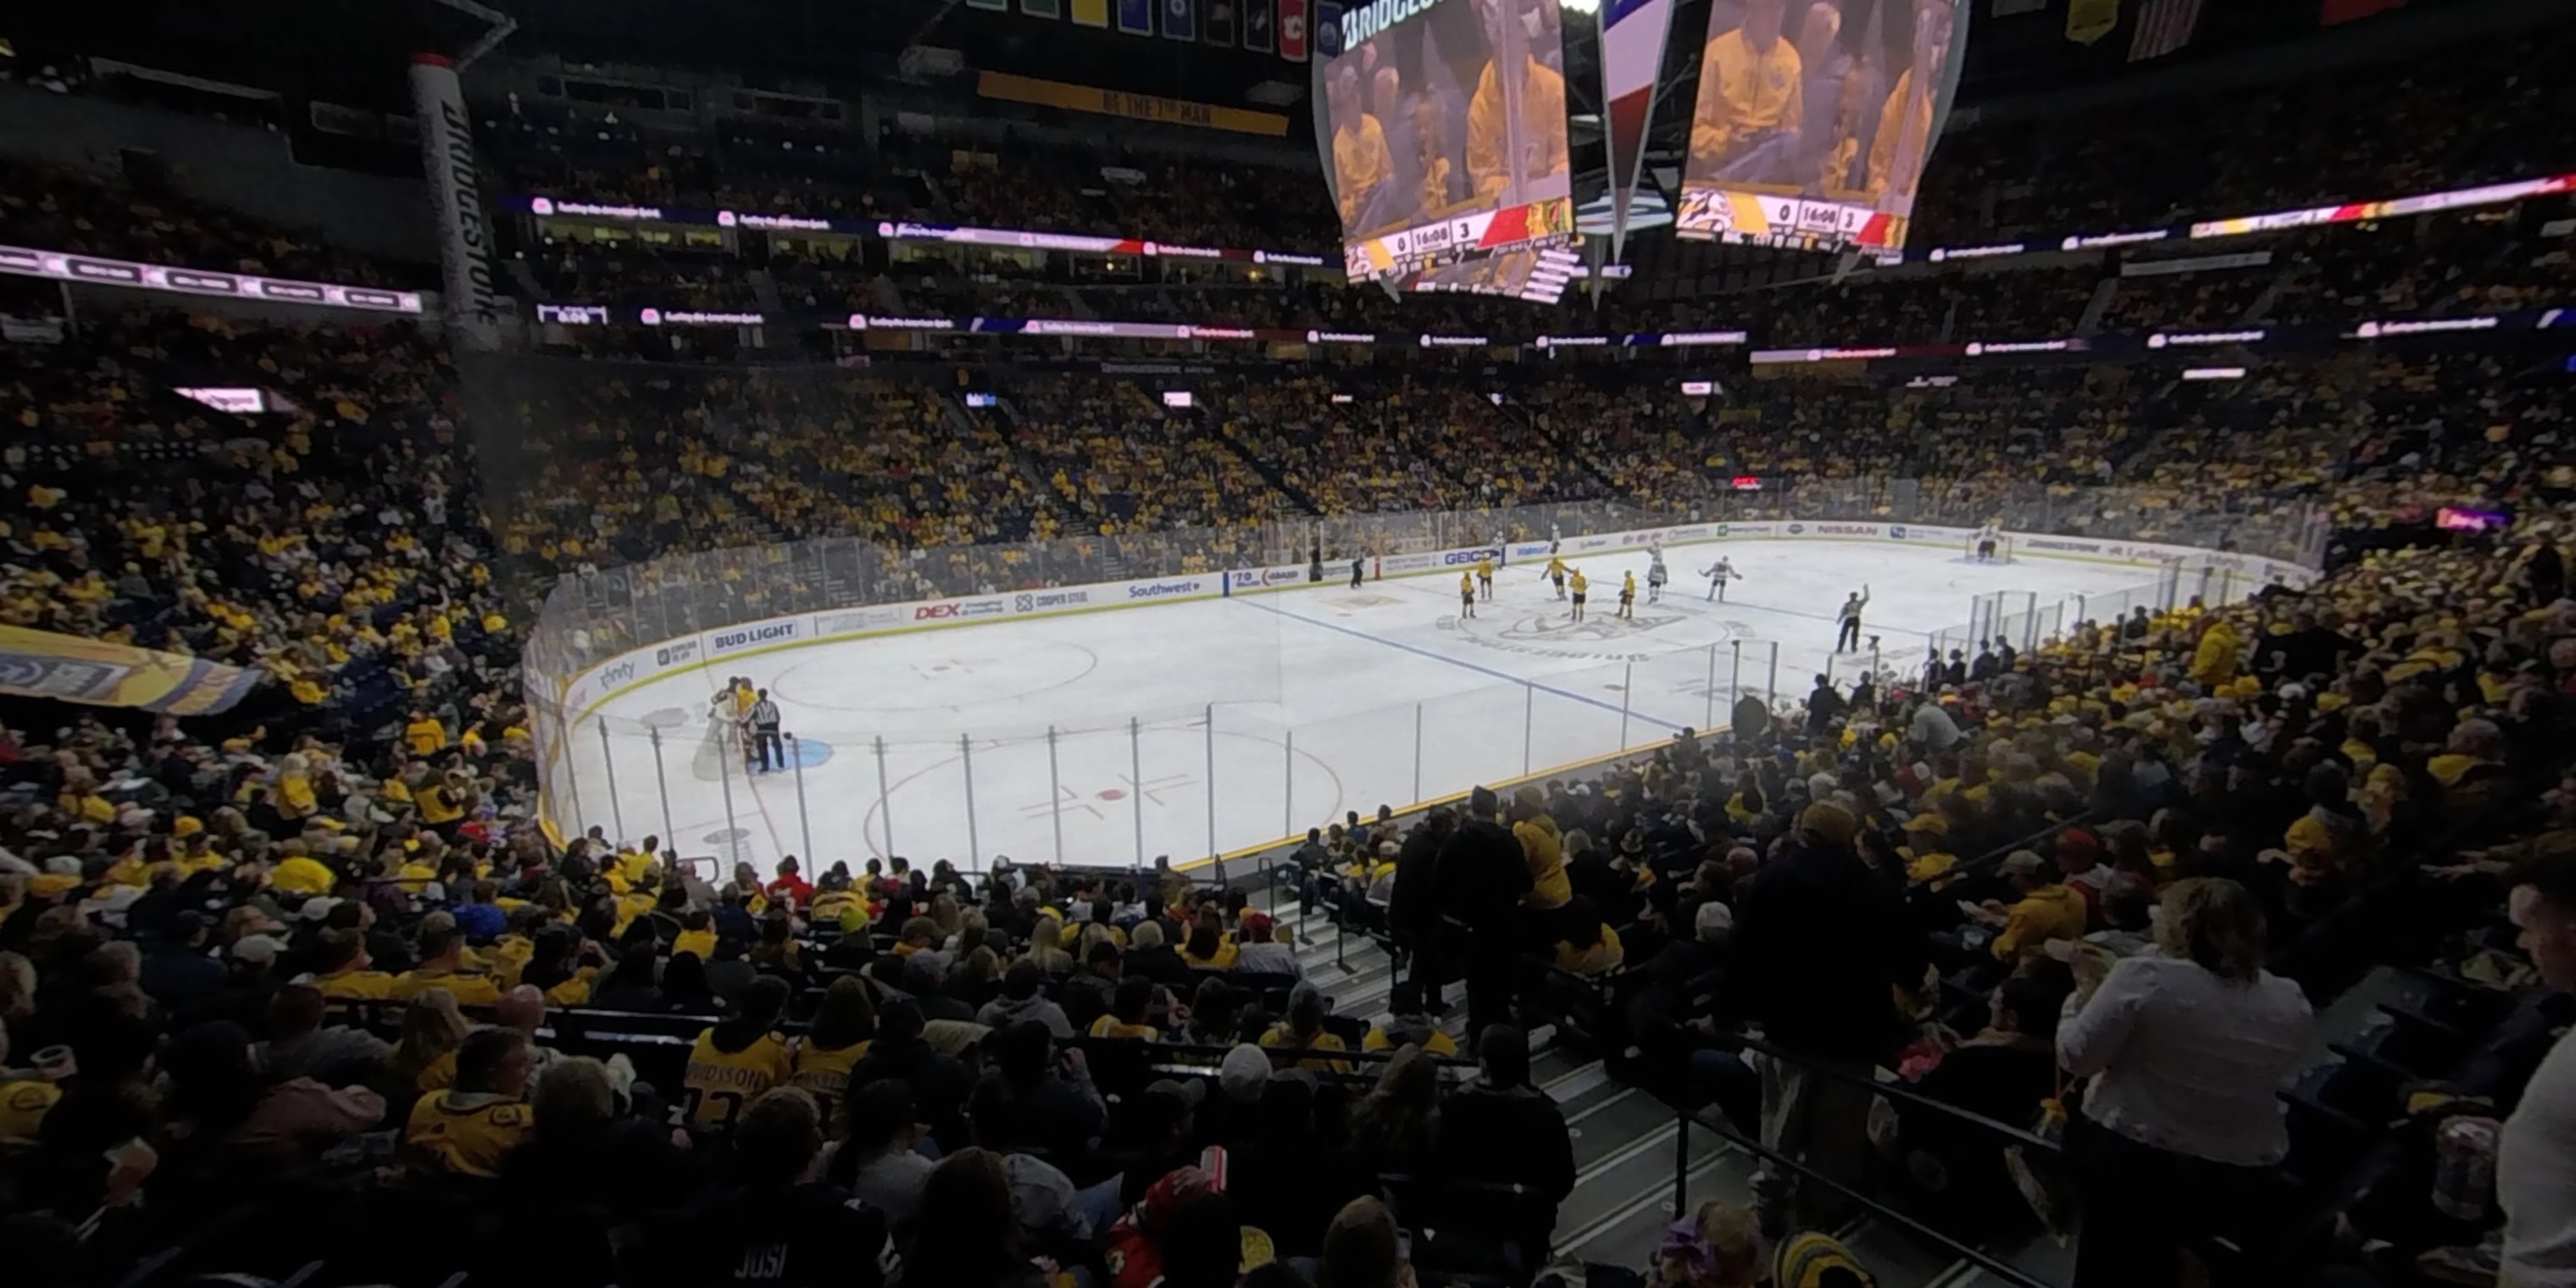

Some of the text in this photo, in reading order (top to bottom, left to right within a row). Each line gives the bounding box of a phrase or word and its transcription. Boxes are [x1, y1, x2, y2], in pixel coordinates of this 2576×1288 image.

[441, 99, 498, 327] BRIDGESTONE
[1779, 204, 1790, 222] 0
[1396, 236, 1407, 253] 0
[1459, 222, 1470, 239] 3
[1817, 525, 1879, 536] NISSAN
[1445, 549, 1492, 566] GEICO
[1128, 581, 1192, 598] Southwest
[914, 603, 961, 620] DEX
[714, 623, 794, 649] BUD LIGHT
